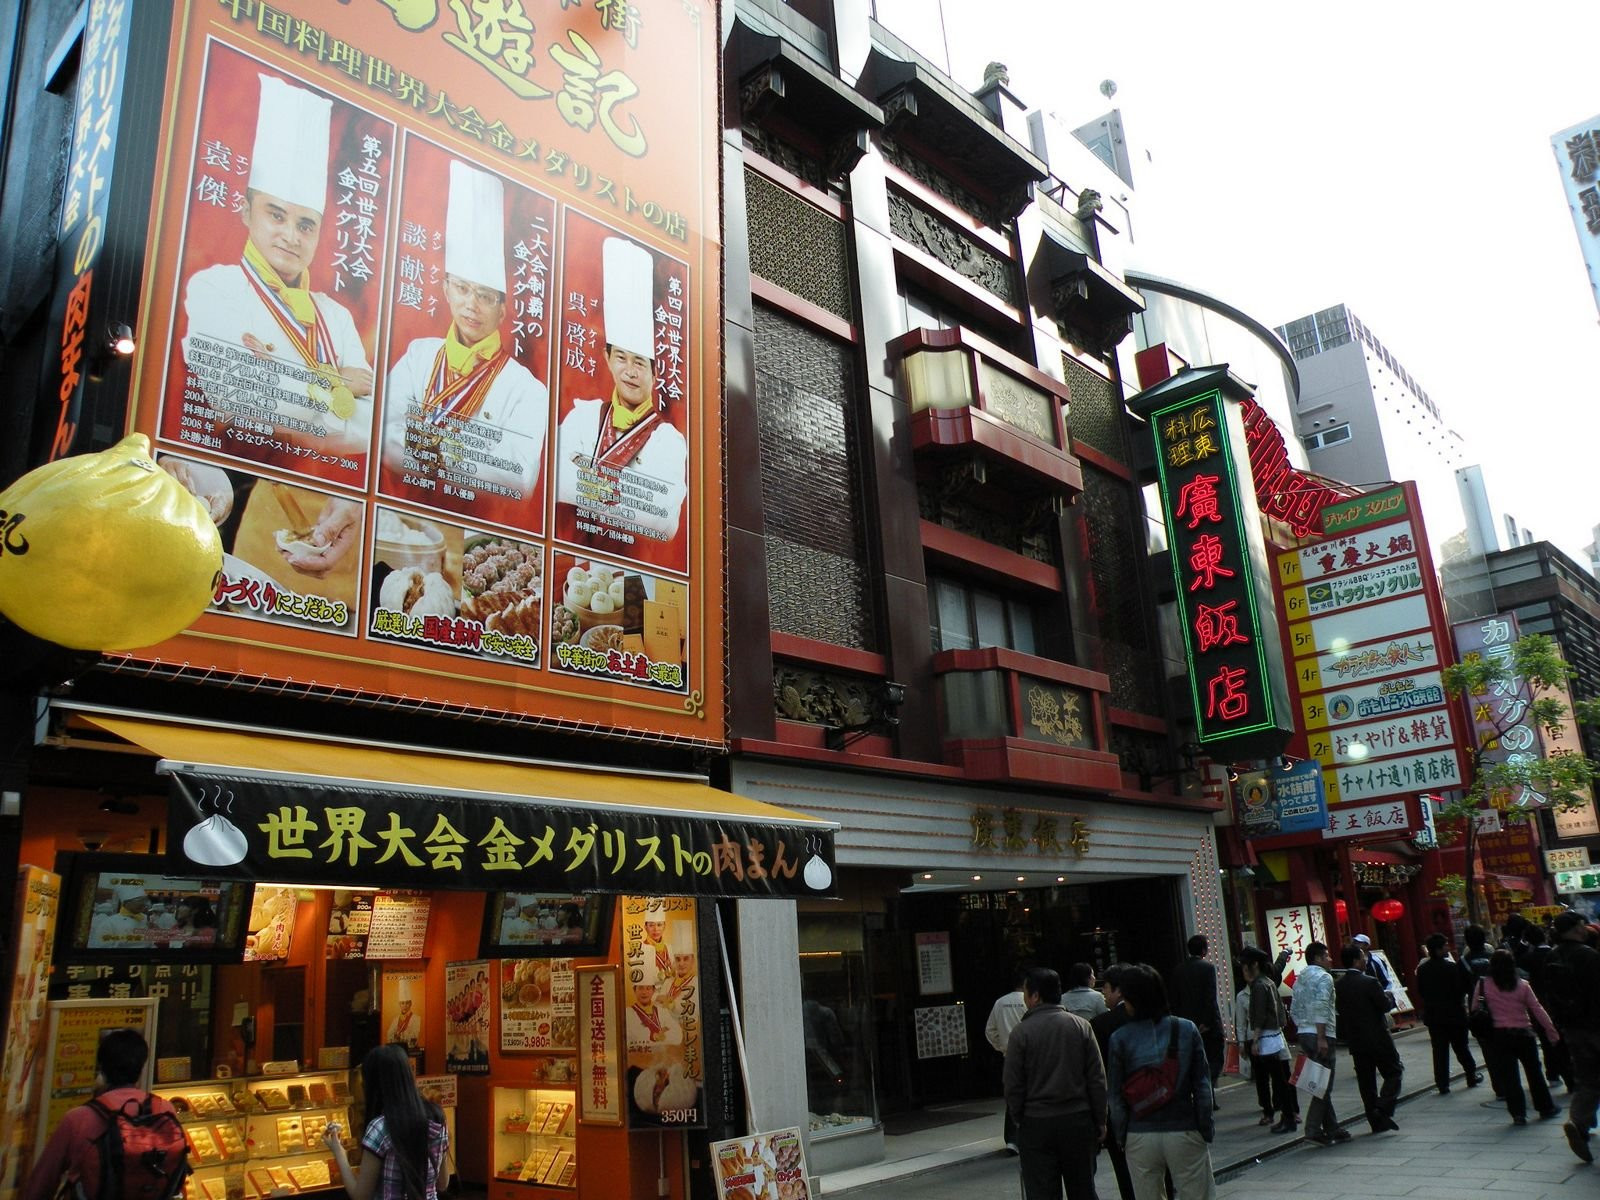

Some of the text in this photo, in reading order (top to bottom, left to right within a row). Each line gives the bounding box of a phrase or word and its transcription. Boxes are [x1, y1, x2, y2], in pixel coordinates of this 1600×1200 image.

[330, 166, 360, 292] 金メダリスト
[350, 134, 382, 282] 第五回世界大会
[510, 240, 533, 358] 金メダリスト
[526, 216, 550, 338] 二大会制覇の
[654, 303, 671, 411] 金メダリスト
[667, 276, 684, 401] 第四回世界大会
[1189, 405, 1220, 462] 広東
[1325, 506, 1362, 529] チャイナ
[1283, 534, 1412, 575] 7F 重慶火鍋
[1175, 473, 1250, 721] 廣東飯店
[1289, 597, 1305, 610] 6F
[373, 607, 538, 661] 厳選した国産素材で安心安全
[1295, 631, 1312, 646] 5F
[557, 642, 682, 687] 中華街のお土産に最適
[1301, 667, 1318, 682] 4F
[1307, 686, 1443, 719] 3F おもしろ水族館
[1314, 742, 1330, 757] 2F
[1341, 754, 1456, 794] チャイナ通り商店街
[257, 805, 800, 881] 世界大会金メダリストの肉まん
[626, 924, 645, 984] 世界一の
[1289, 909, 1306, 962] チャイナ
[590, 974, 609, 1111] 全国送料無料
[680, 985, 701, 1080] フカヒレまん
[661, 1107, 697, 1124] 350円
